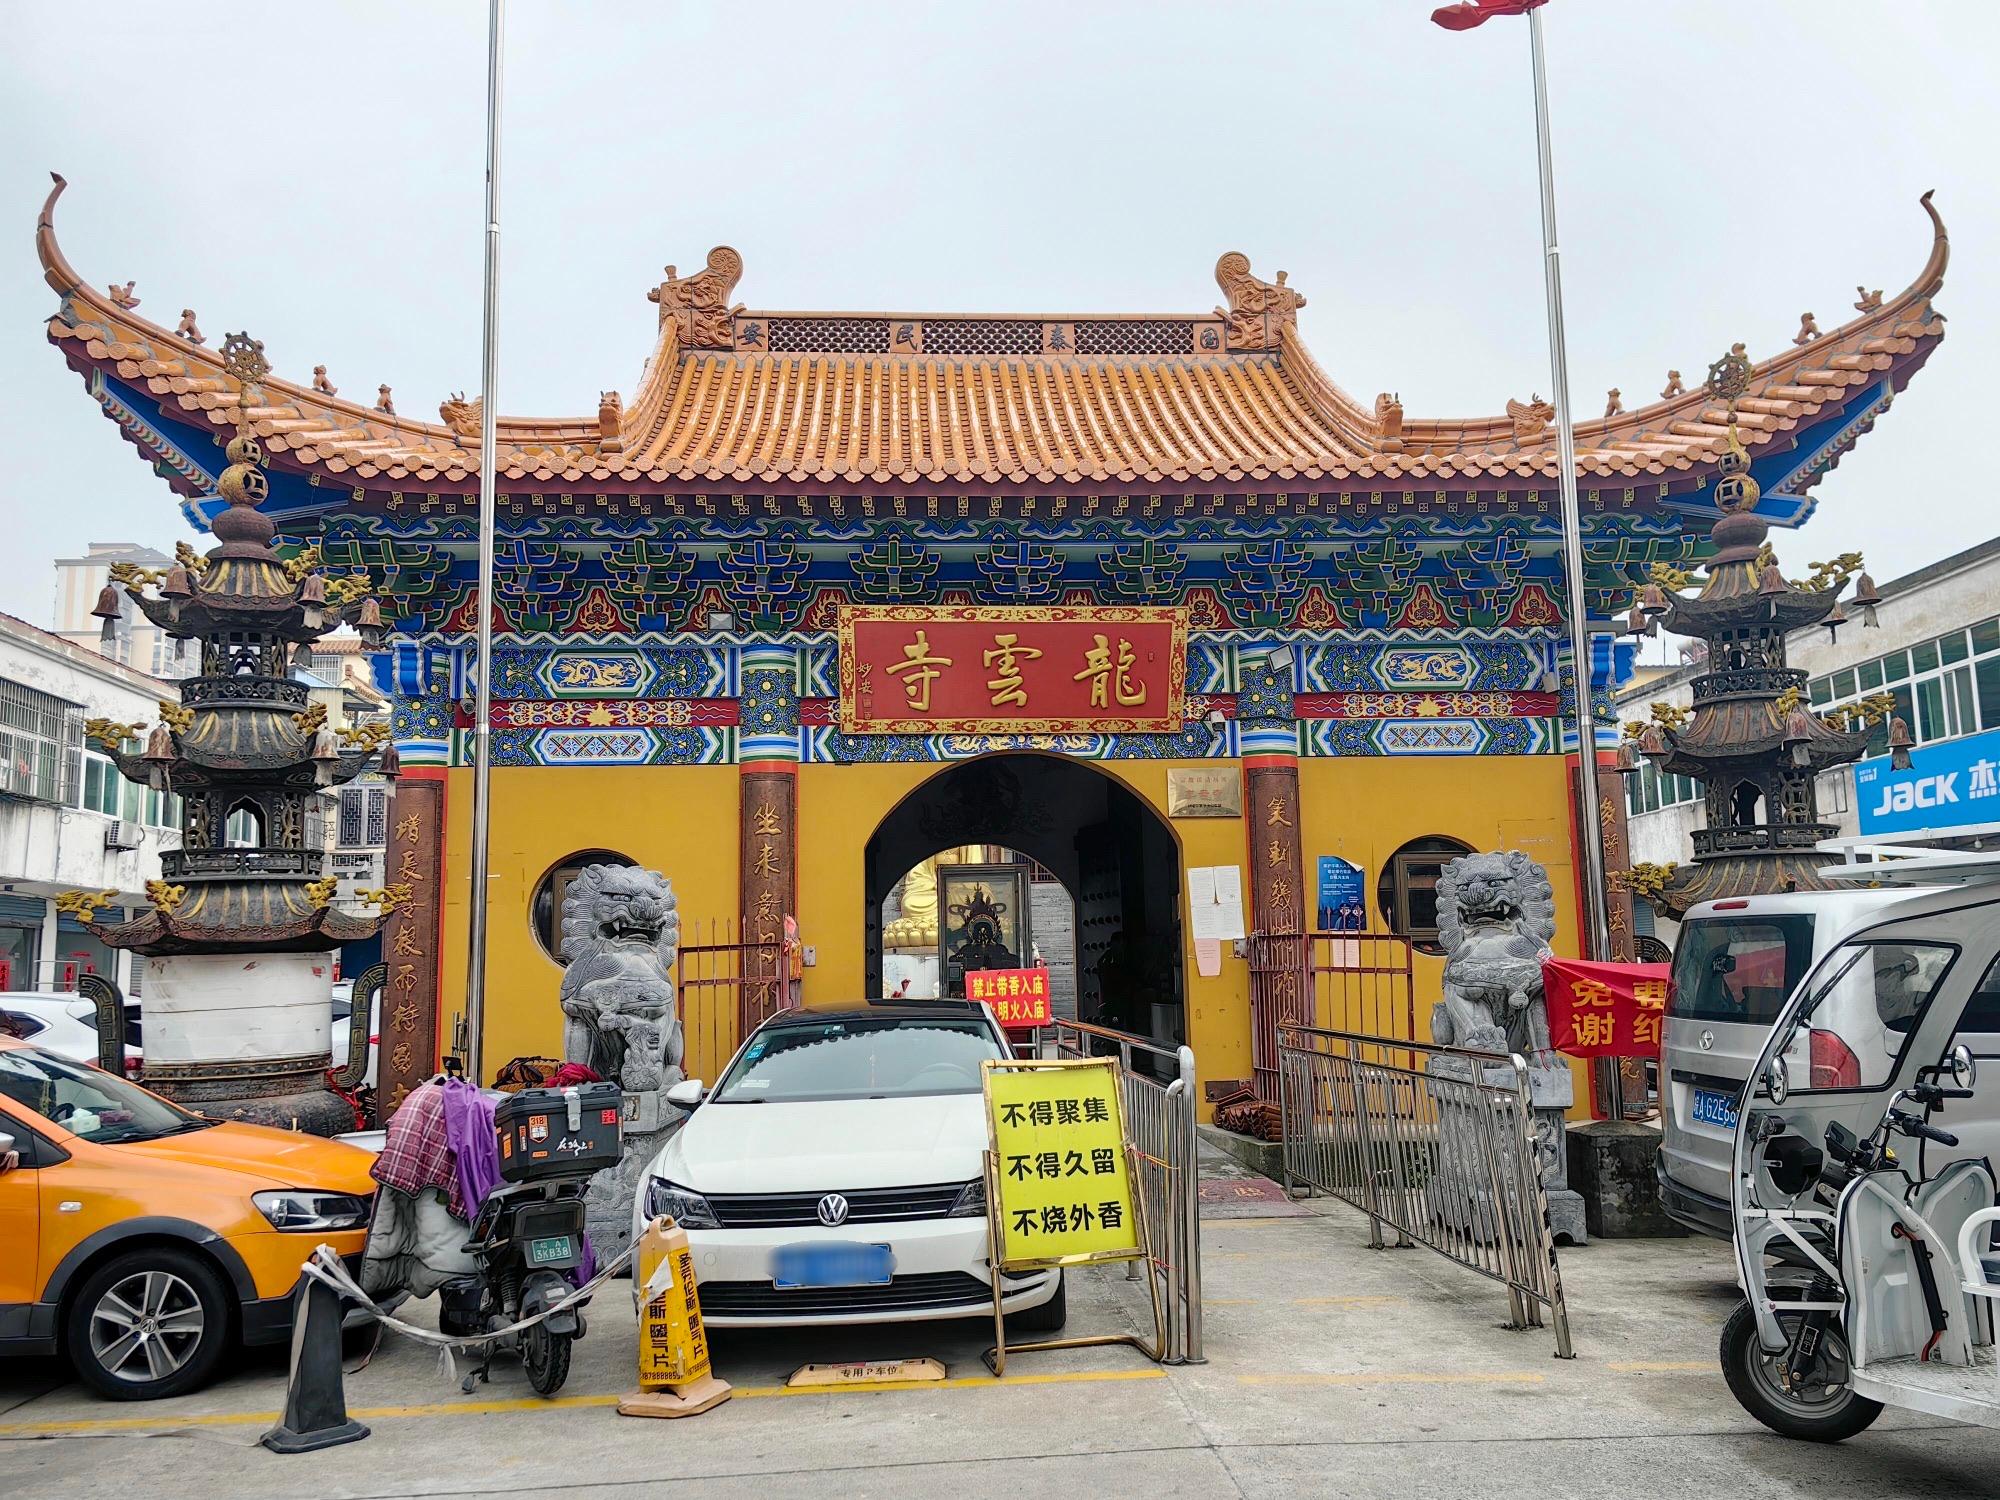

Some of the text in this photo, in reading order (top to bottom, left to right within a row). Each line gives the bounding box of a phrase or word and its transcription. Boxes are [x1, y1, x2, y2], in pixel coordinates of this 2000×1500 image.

[1968, 757, 2000, 801] 杰
[972, 974, 1045, 998] 禁止带香入庙
[1000, 1096, 1110, 1128] 不得聚集
[1006, 1147, 1117, 1182] 不得久留
[1011, 1199, 1123, 1237] 不烧外香
[650, 1323, 669, 1369] 暖气片
[687, 1313, 704, 1360] 暖气片
